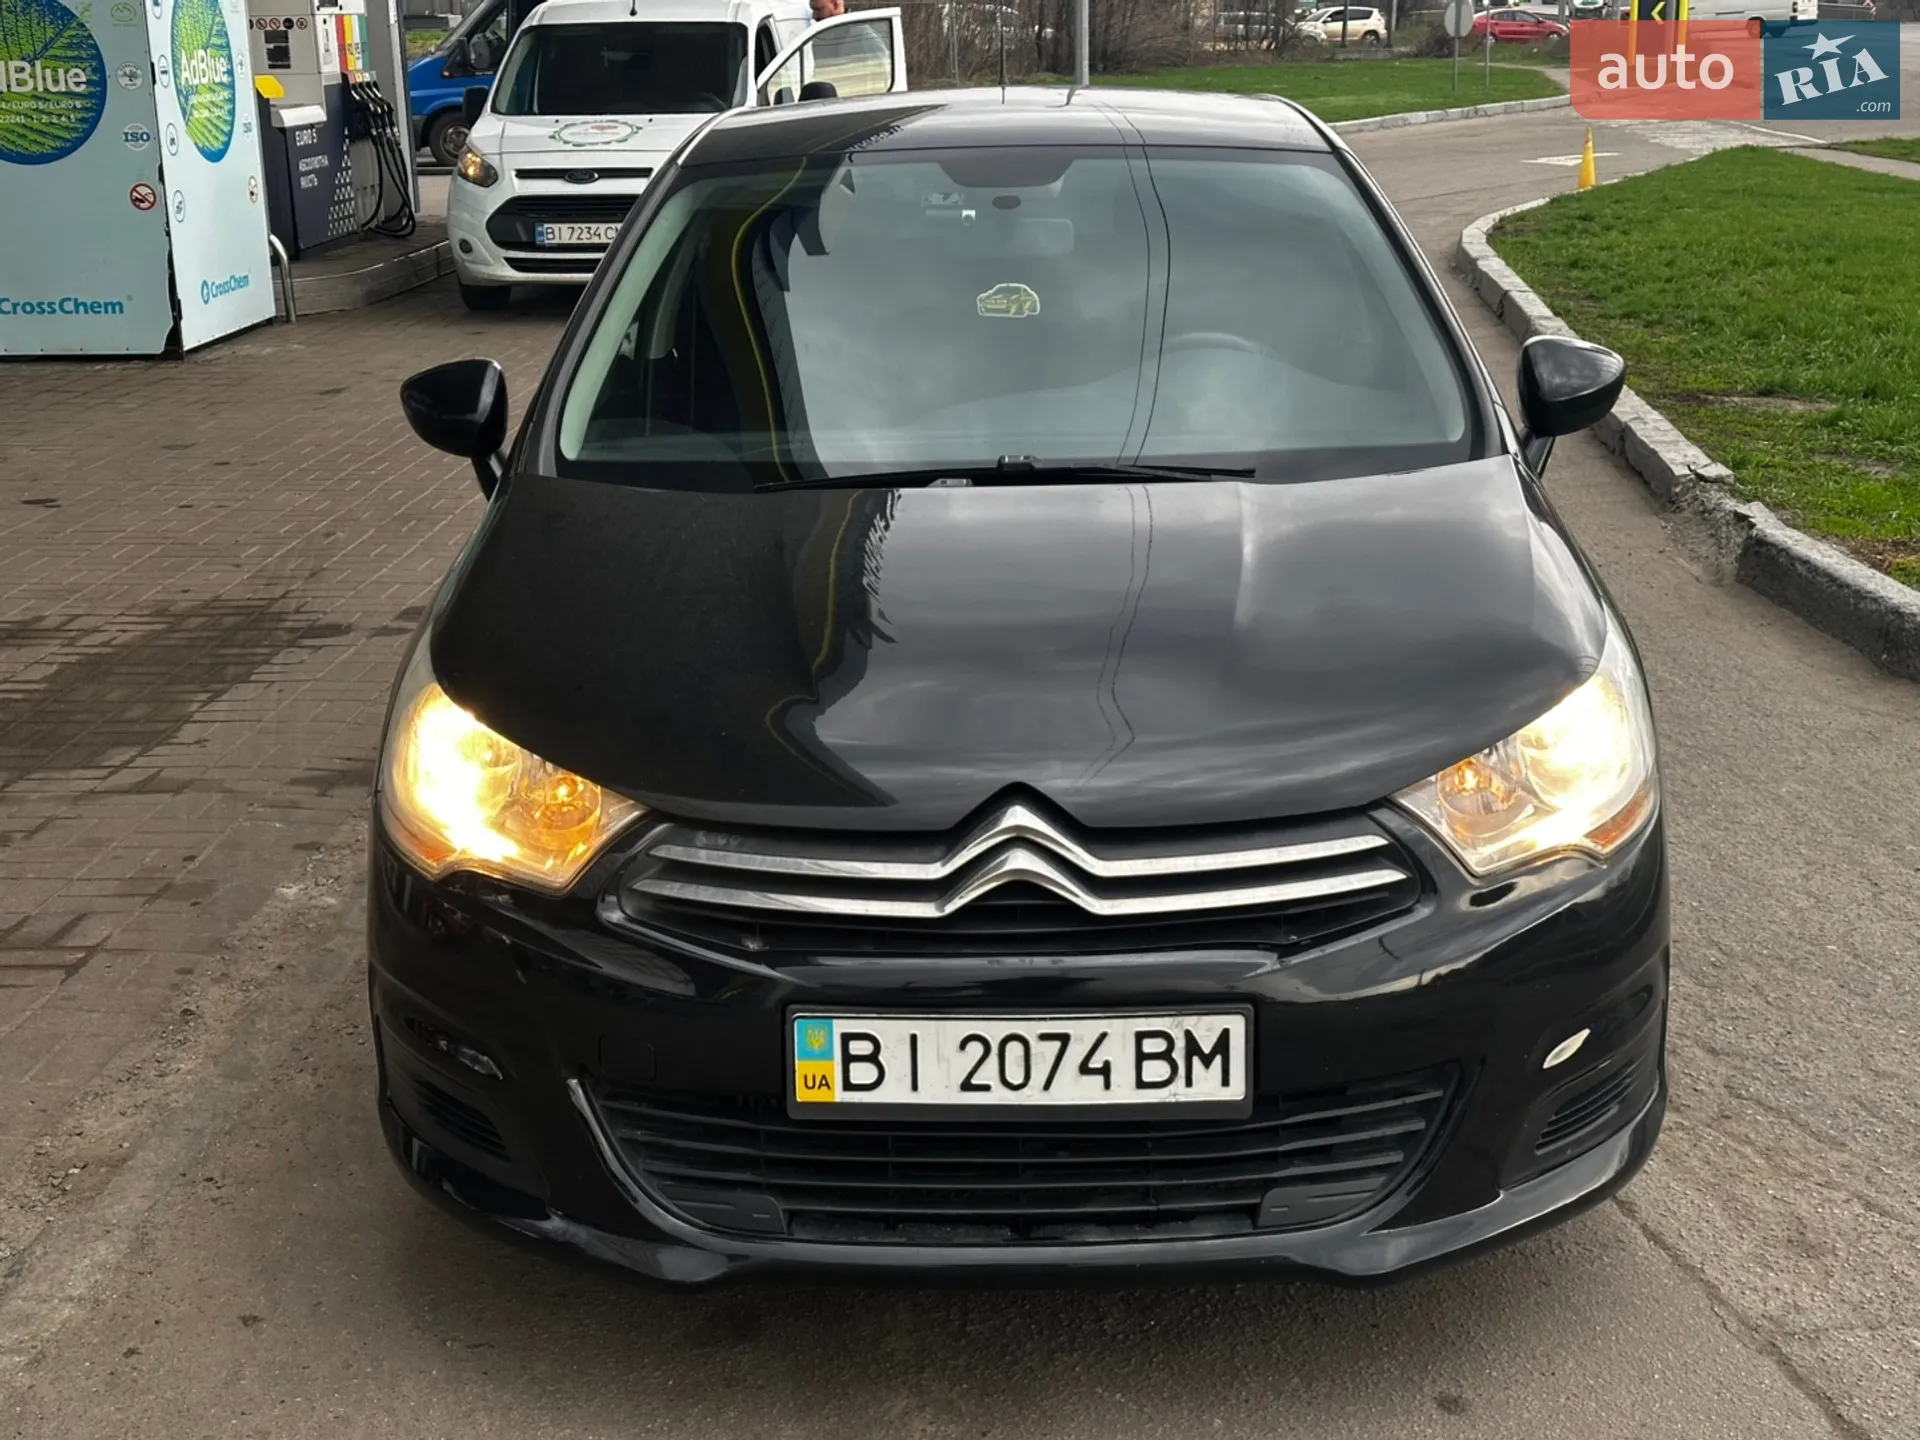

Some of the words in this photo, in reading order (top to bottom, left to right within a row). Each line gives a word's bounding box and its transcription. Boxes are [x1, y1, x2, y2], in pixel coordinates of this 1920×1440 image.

[181, 48, 228, 86] AdBlue
[122, 131, 151, 143] ISO
[545, 226, 562, 241] BI
[568, 226, 601, 241] 7234
[211, 274, 250, 298] CrossChem
[0, 297, 124, 315] CrossChem
[840, 1031, 919, 1092] BI
[958, 1031, 1112, 1092] 2074
[1134, 1027, 1231, 1091] BM
[803, 1073, 831, 1091] UA
